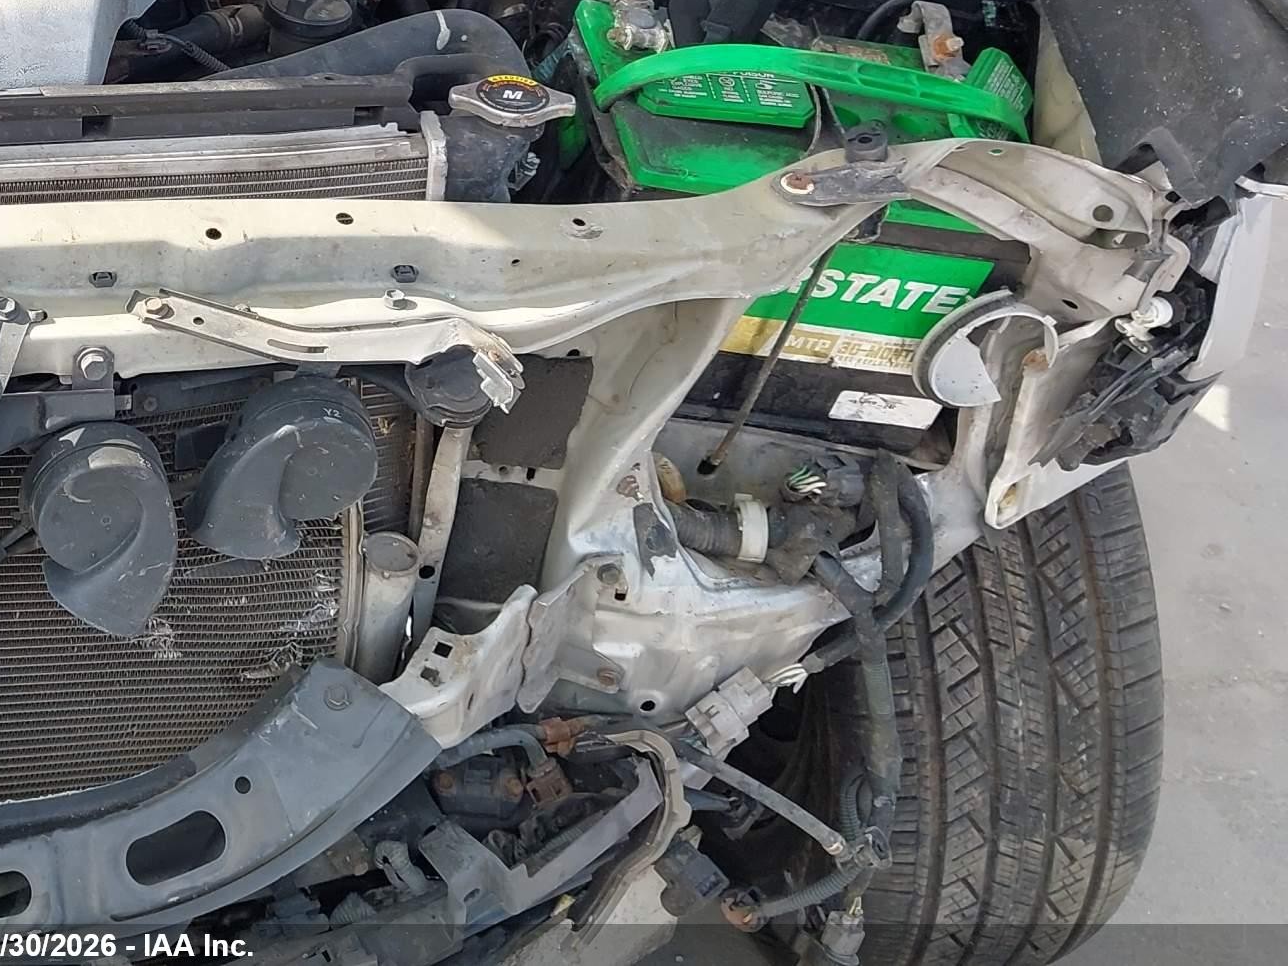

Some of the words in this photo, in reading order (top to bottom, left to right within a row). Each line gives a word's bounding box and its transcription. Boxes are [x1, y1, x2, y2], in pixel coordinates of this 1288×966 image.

[502, 89, 524, 100] M
[784, 335, 832, 353] MTP
[322, 407, 343, 418] Y2
